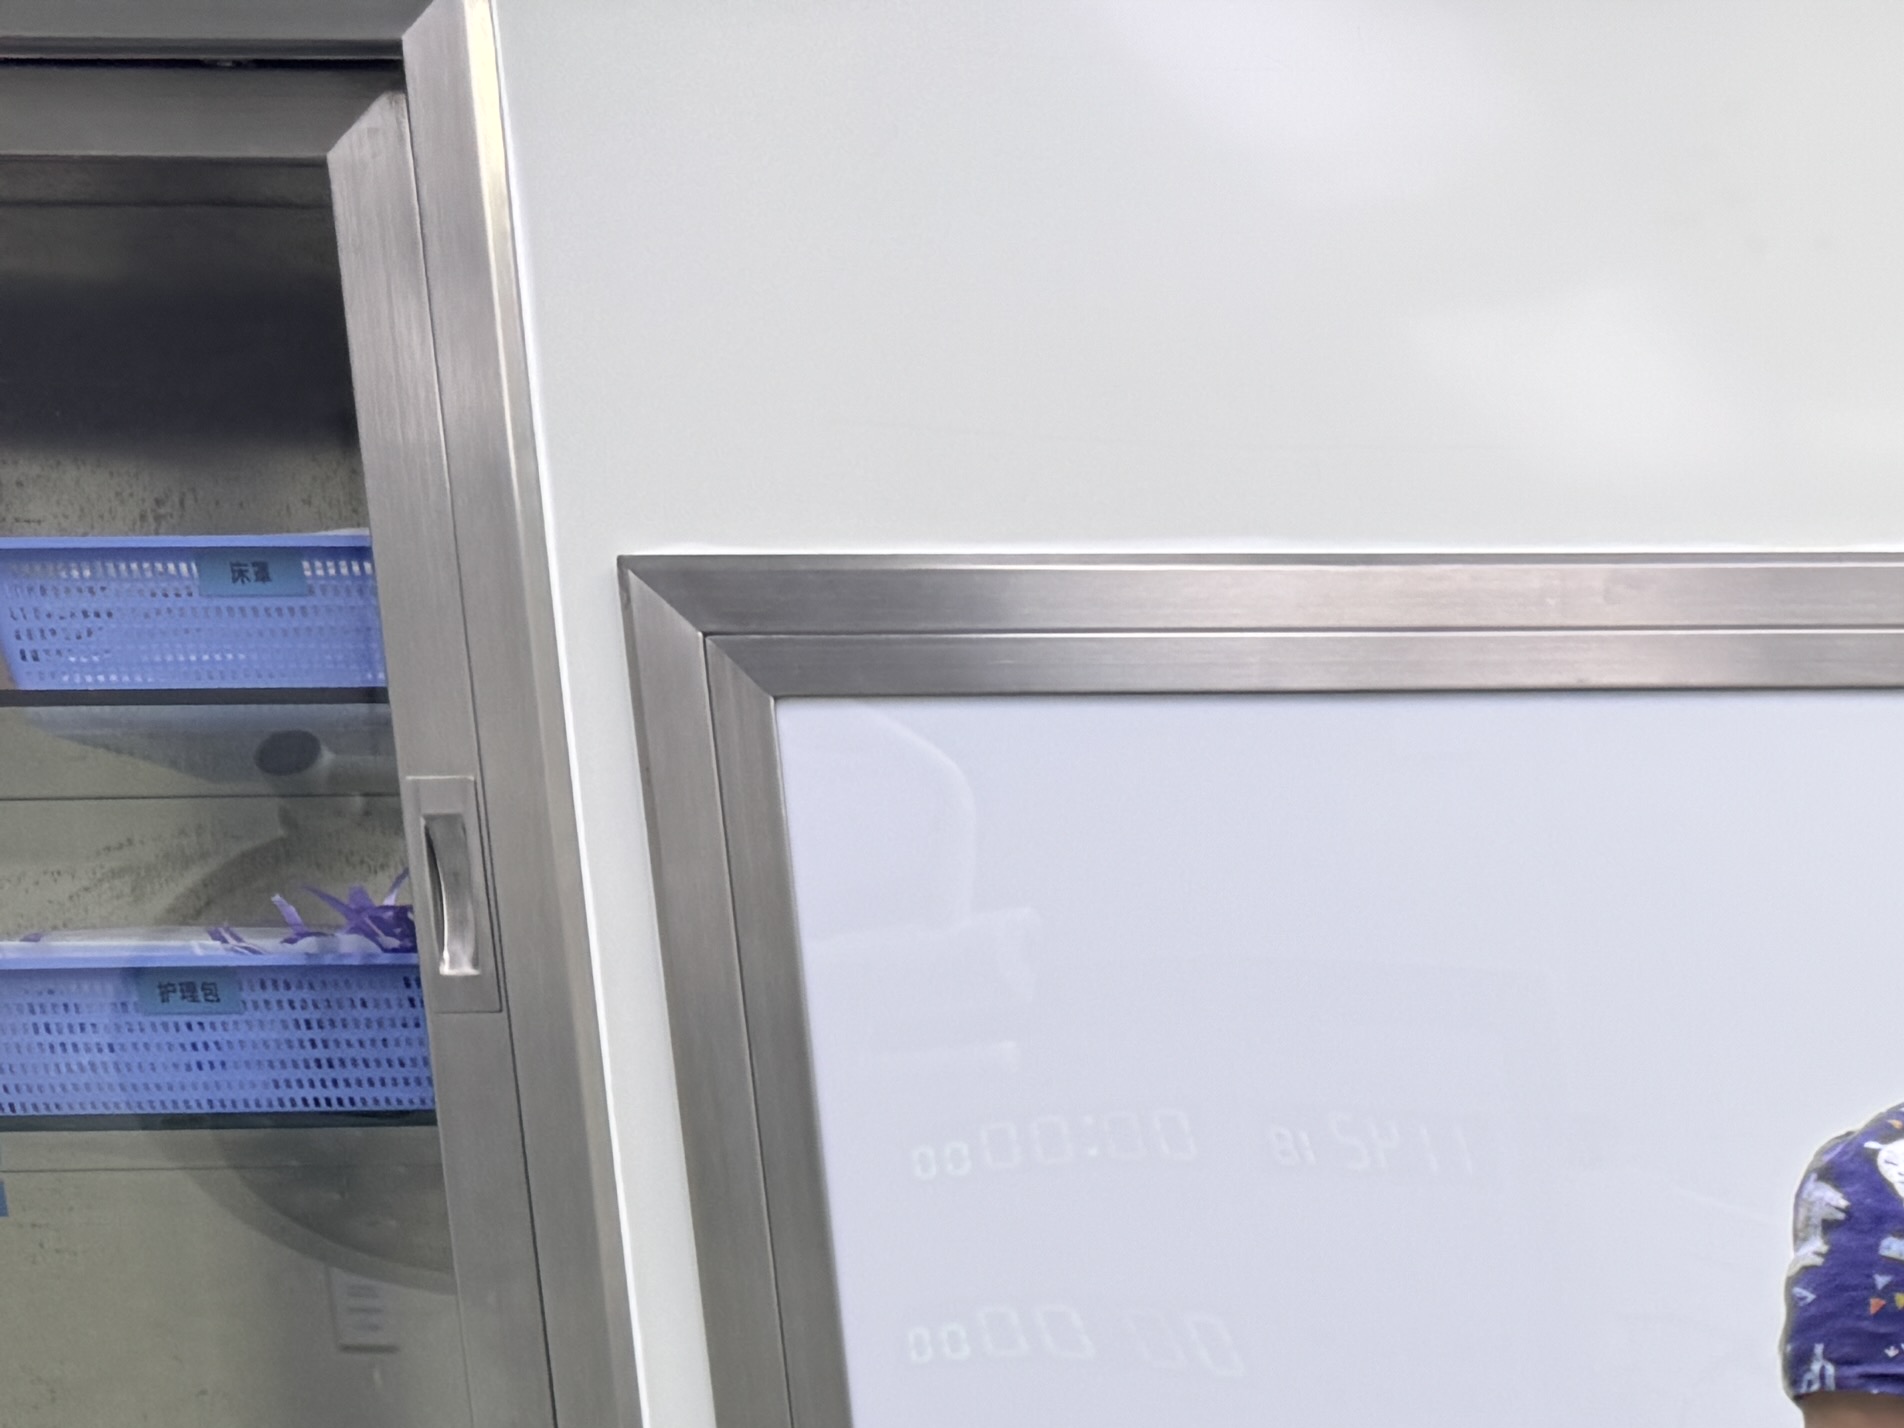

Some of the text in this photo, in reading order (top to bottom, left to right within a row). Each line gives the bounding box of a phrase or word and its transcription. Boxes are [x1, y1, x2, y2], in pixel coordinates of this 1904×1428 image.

[228, 559, 273, 587] 床罩
[157, 979, 221, 1005] 护理包
